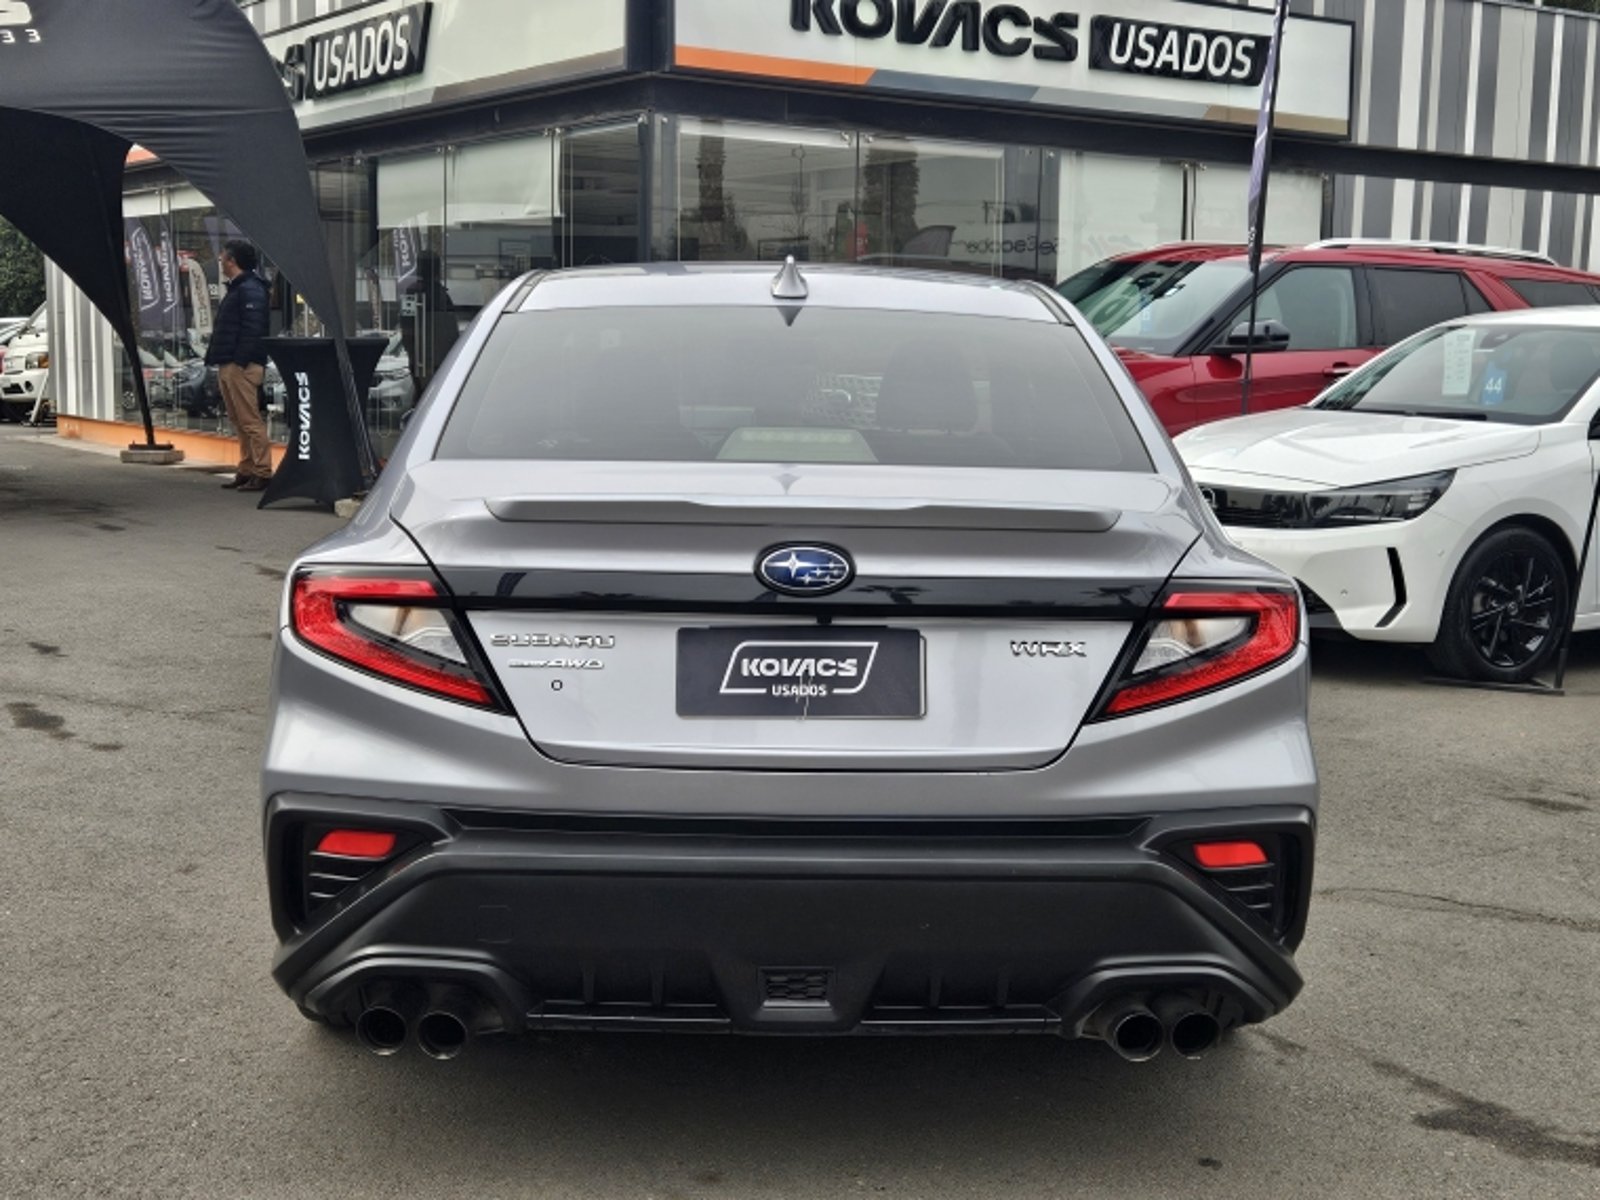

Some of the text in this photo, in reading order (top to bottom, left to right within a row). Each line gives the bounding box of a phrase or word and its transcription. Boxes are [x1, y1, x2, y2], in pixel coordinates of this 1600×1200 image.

[790, 0, 1255, 78] KOVACS USADOS
[313, 15, 409, 91] USADOS
[294, 372, 311, 460] KOVACS
[490, 633, 616, 648] SUBARU
[1010, 640, 1087, 657] WRX
[740, 658, 858, 677] KOVACS
[771, 684, 828, 697] USADOS
